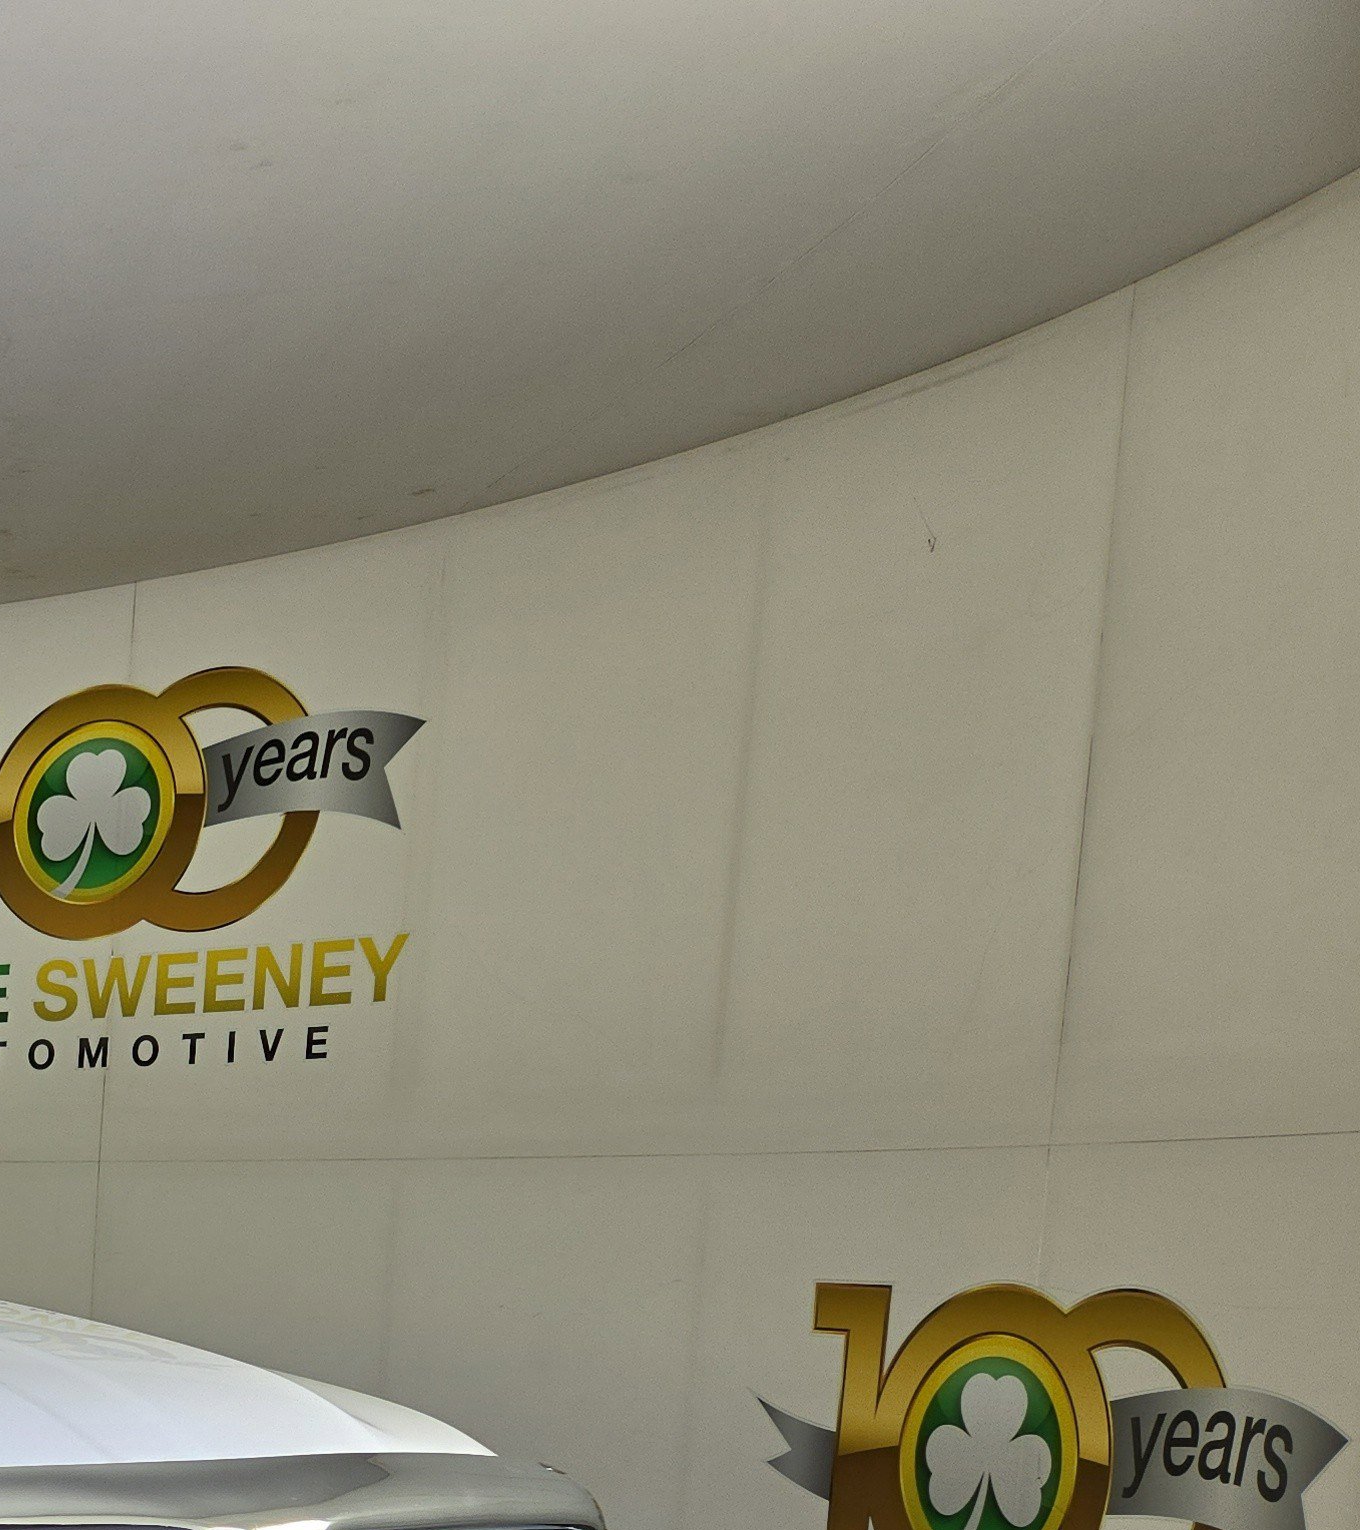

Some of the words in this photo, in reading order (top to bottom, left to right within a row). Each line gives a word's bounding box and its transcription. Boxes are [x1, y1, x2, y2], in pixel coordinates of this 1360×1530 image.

[216, 724, 375, 812] years
[33, 933, 411, 1023] SWEENEY
[1121, 1407, 1294, 1502] years
